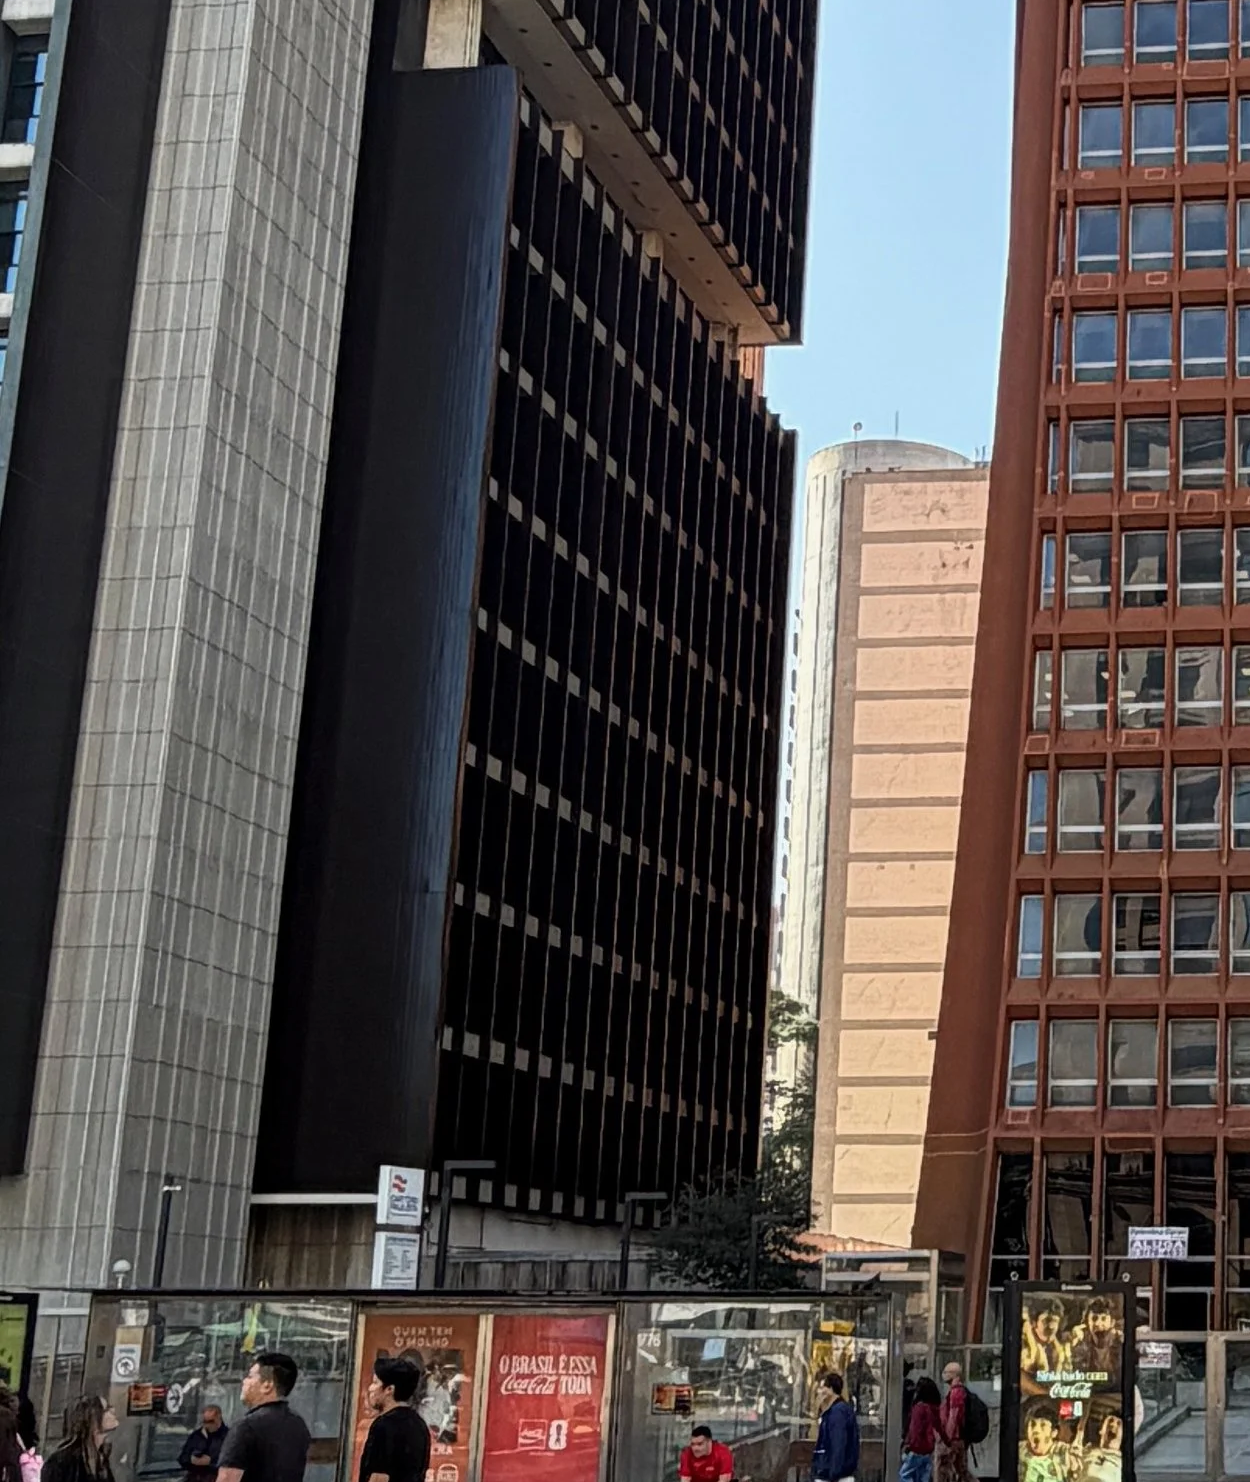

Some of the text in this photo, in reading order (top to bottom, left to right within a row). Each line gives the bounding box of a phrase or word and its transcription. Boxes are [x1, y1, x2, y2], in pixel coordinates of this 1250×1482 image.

[499, 1354, 597, 1376] O BRASIL É ESSA
